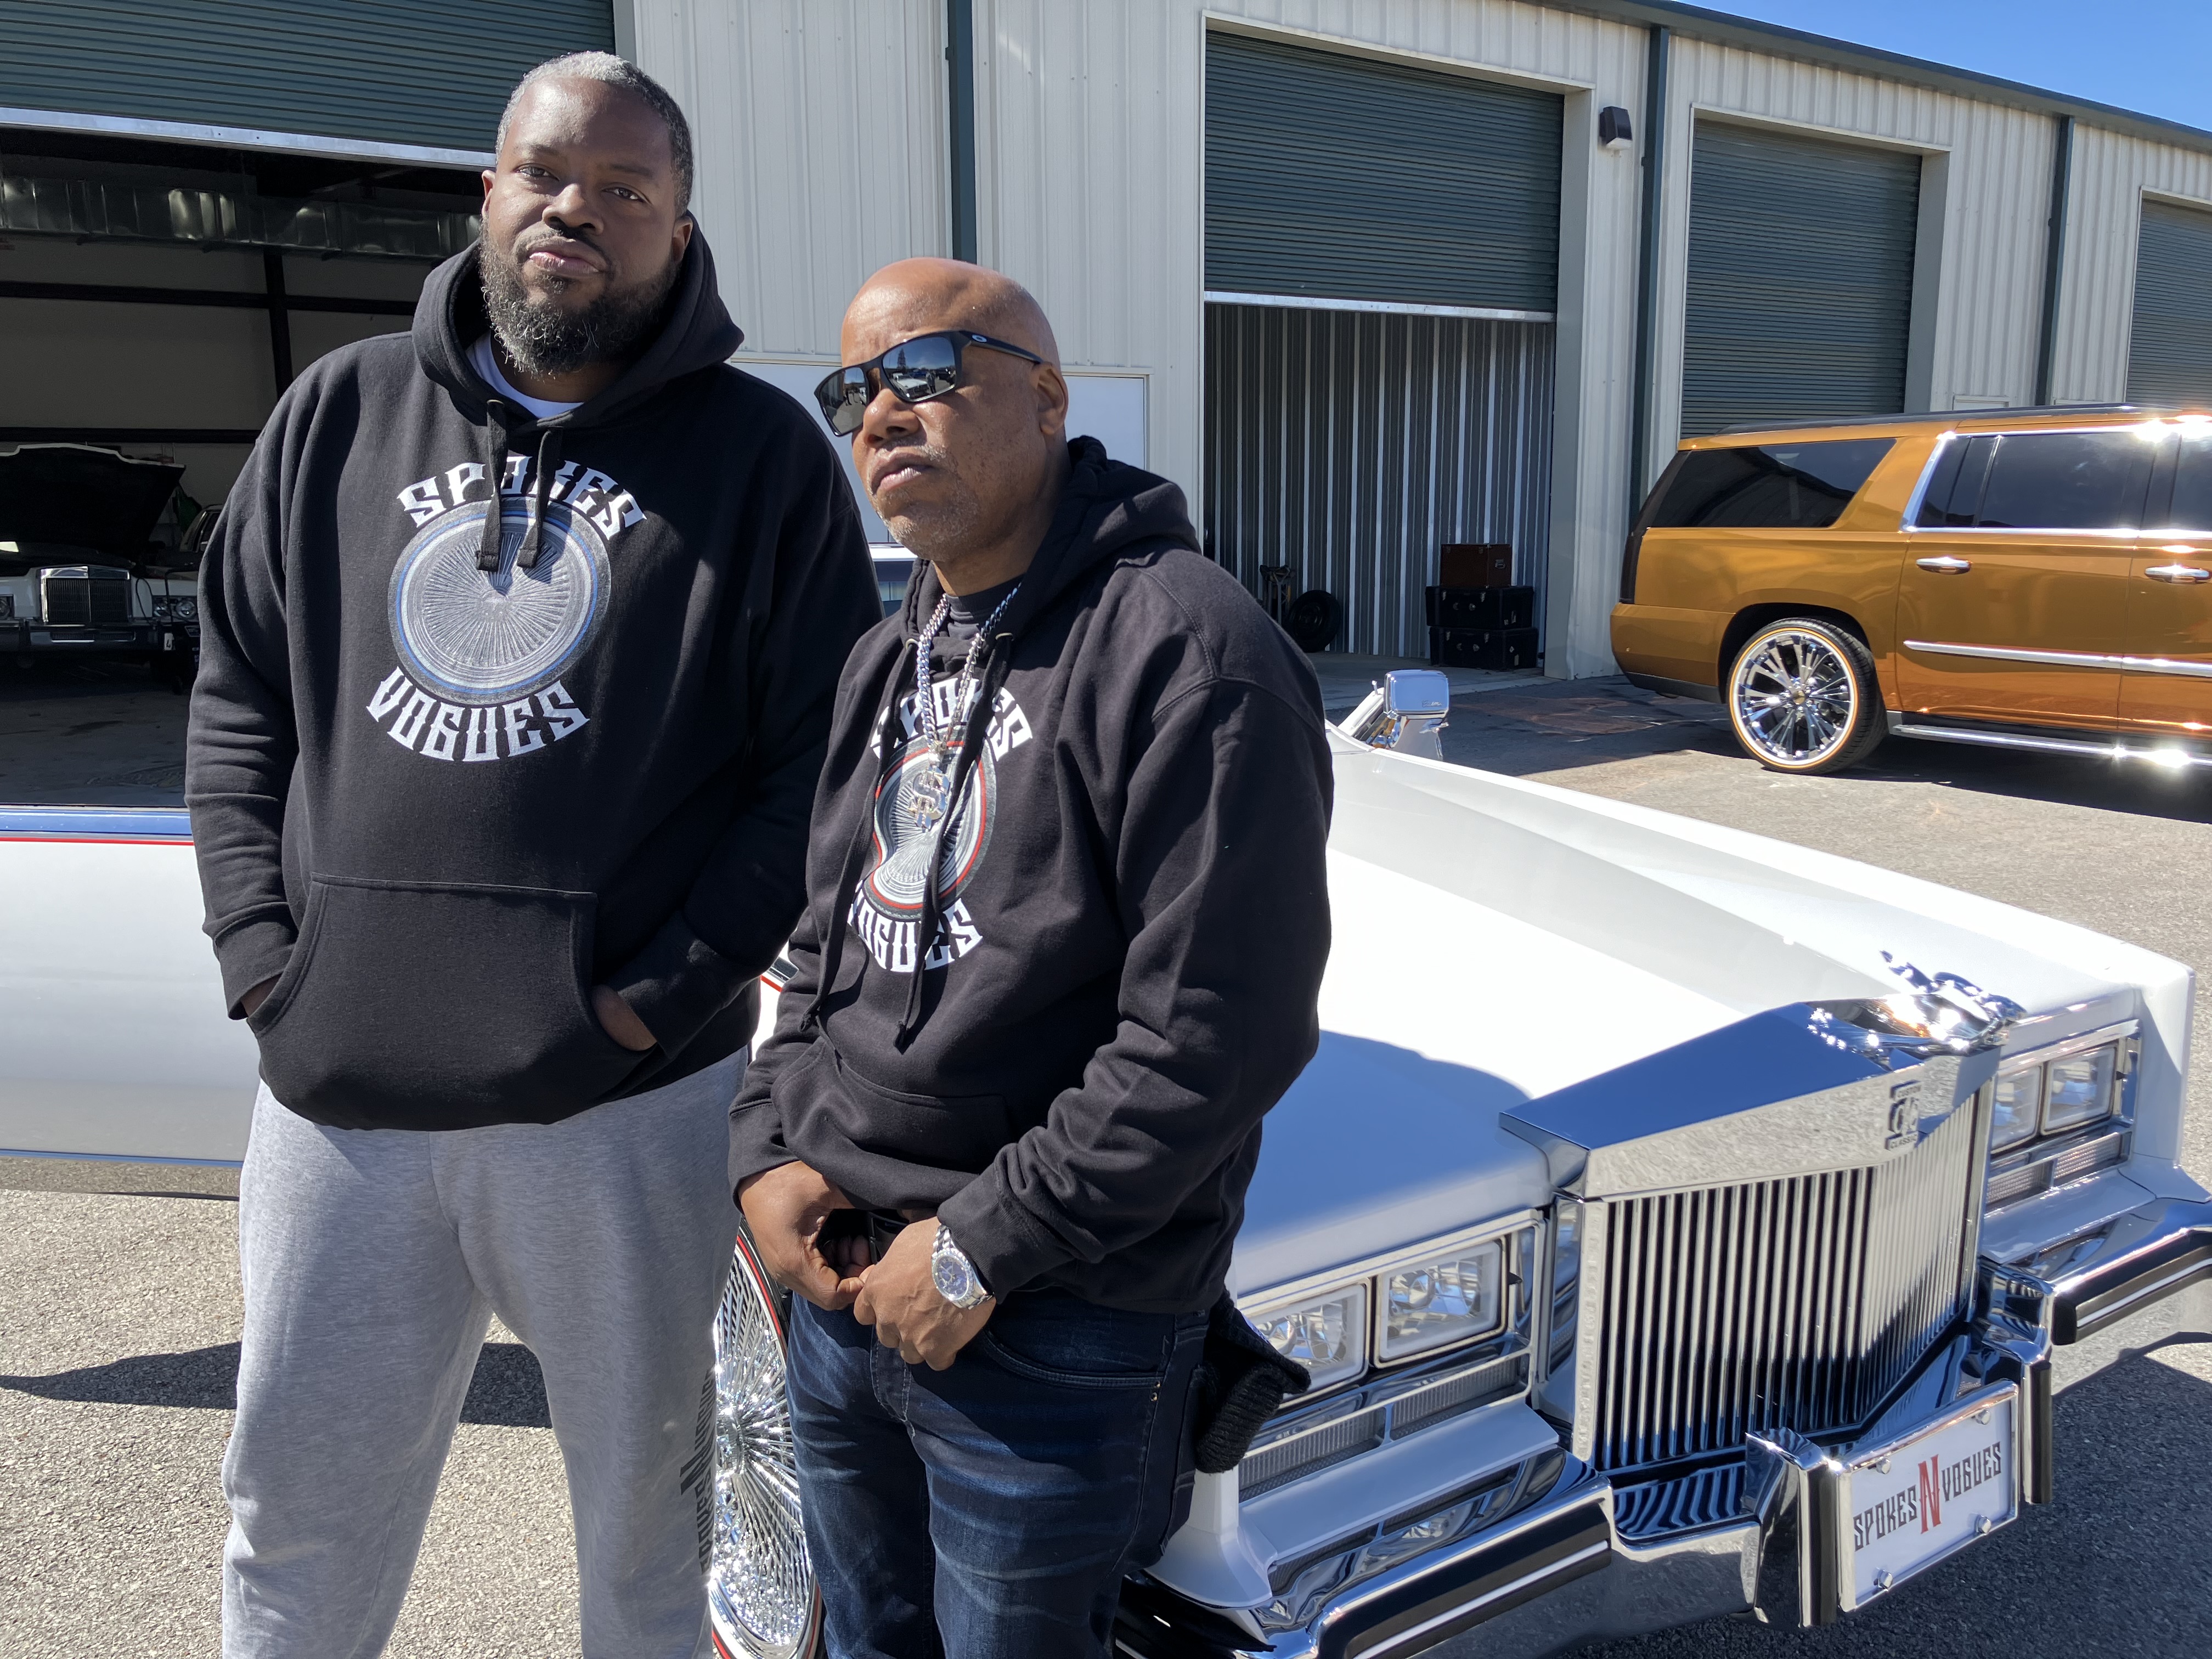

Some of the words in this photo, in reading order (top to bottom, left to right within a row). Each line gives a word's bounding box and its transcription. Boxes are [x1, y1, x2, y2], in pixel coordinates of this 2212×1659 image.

[366, 665, 591, 763] VOGUES
[1853, 1484, 1918, 1553] SPOKES
[1918, 1454, 1942, 1534] N
[1942, 1441, 2002, 1503] VOGUES
